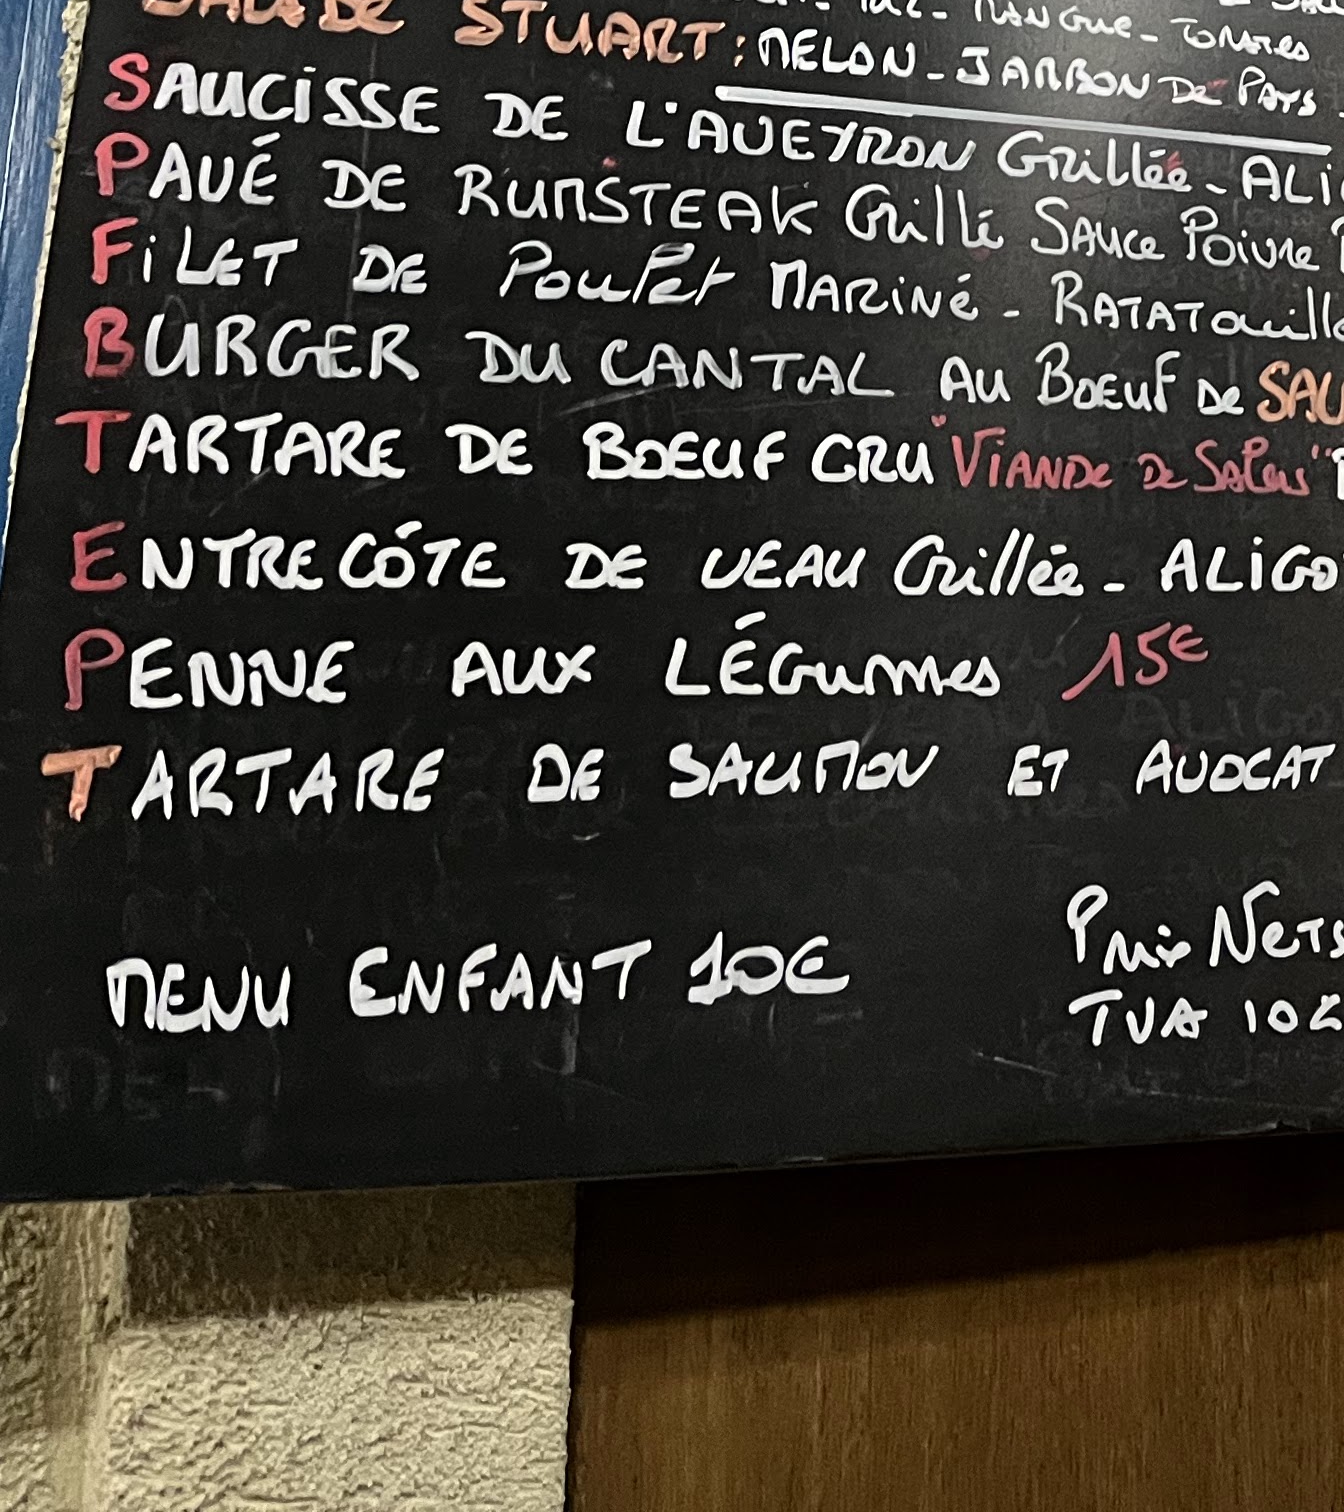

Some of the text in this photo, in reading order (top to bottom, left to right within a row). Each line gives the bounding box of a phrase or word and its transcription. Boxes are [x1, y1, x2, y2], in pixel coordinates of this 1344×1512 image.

[757, 28, 915, 79] MELON
[484, 93, 569, 141] DE
[322, 159, 406, 211] DE
[454, 164, 818, 234] RUMSTEAK
[353, 245, 428, 294] DE
[83, 306, 419, 382] BURGER
[464, 330, 572, 385] DU
[600, 339, 895, 398] CANTAL
[940, 356, 1011, 404] AU
[55, 410, 406, 477] TARTARE
[445, 424, 533, 475] DE
[812, 433, 934, 485] CRU
[565, 543, 647, 590] DE
[64, 621, 1208, 711] PENNE AUX 15€
[41, 744, 444, 821] TARTARE
[527, 743, 604, 803] DE
[1007, 745, 1069, 796] ET
[106, 957, 290, 1032] MENU
[348, 940, 652, 1016] ENFANT
[687, 931, 850, 1005] 10€
[1069, 991, 1207, 1048] TVA
